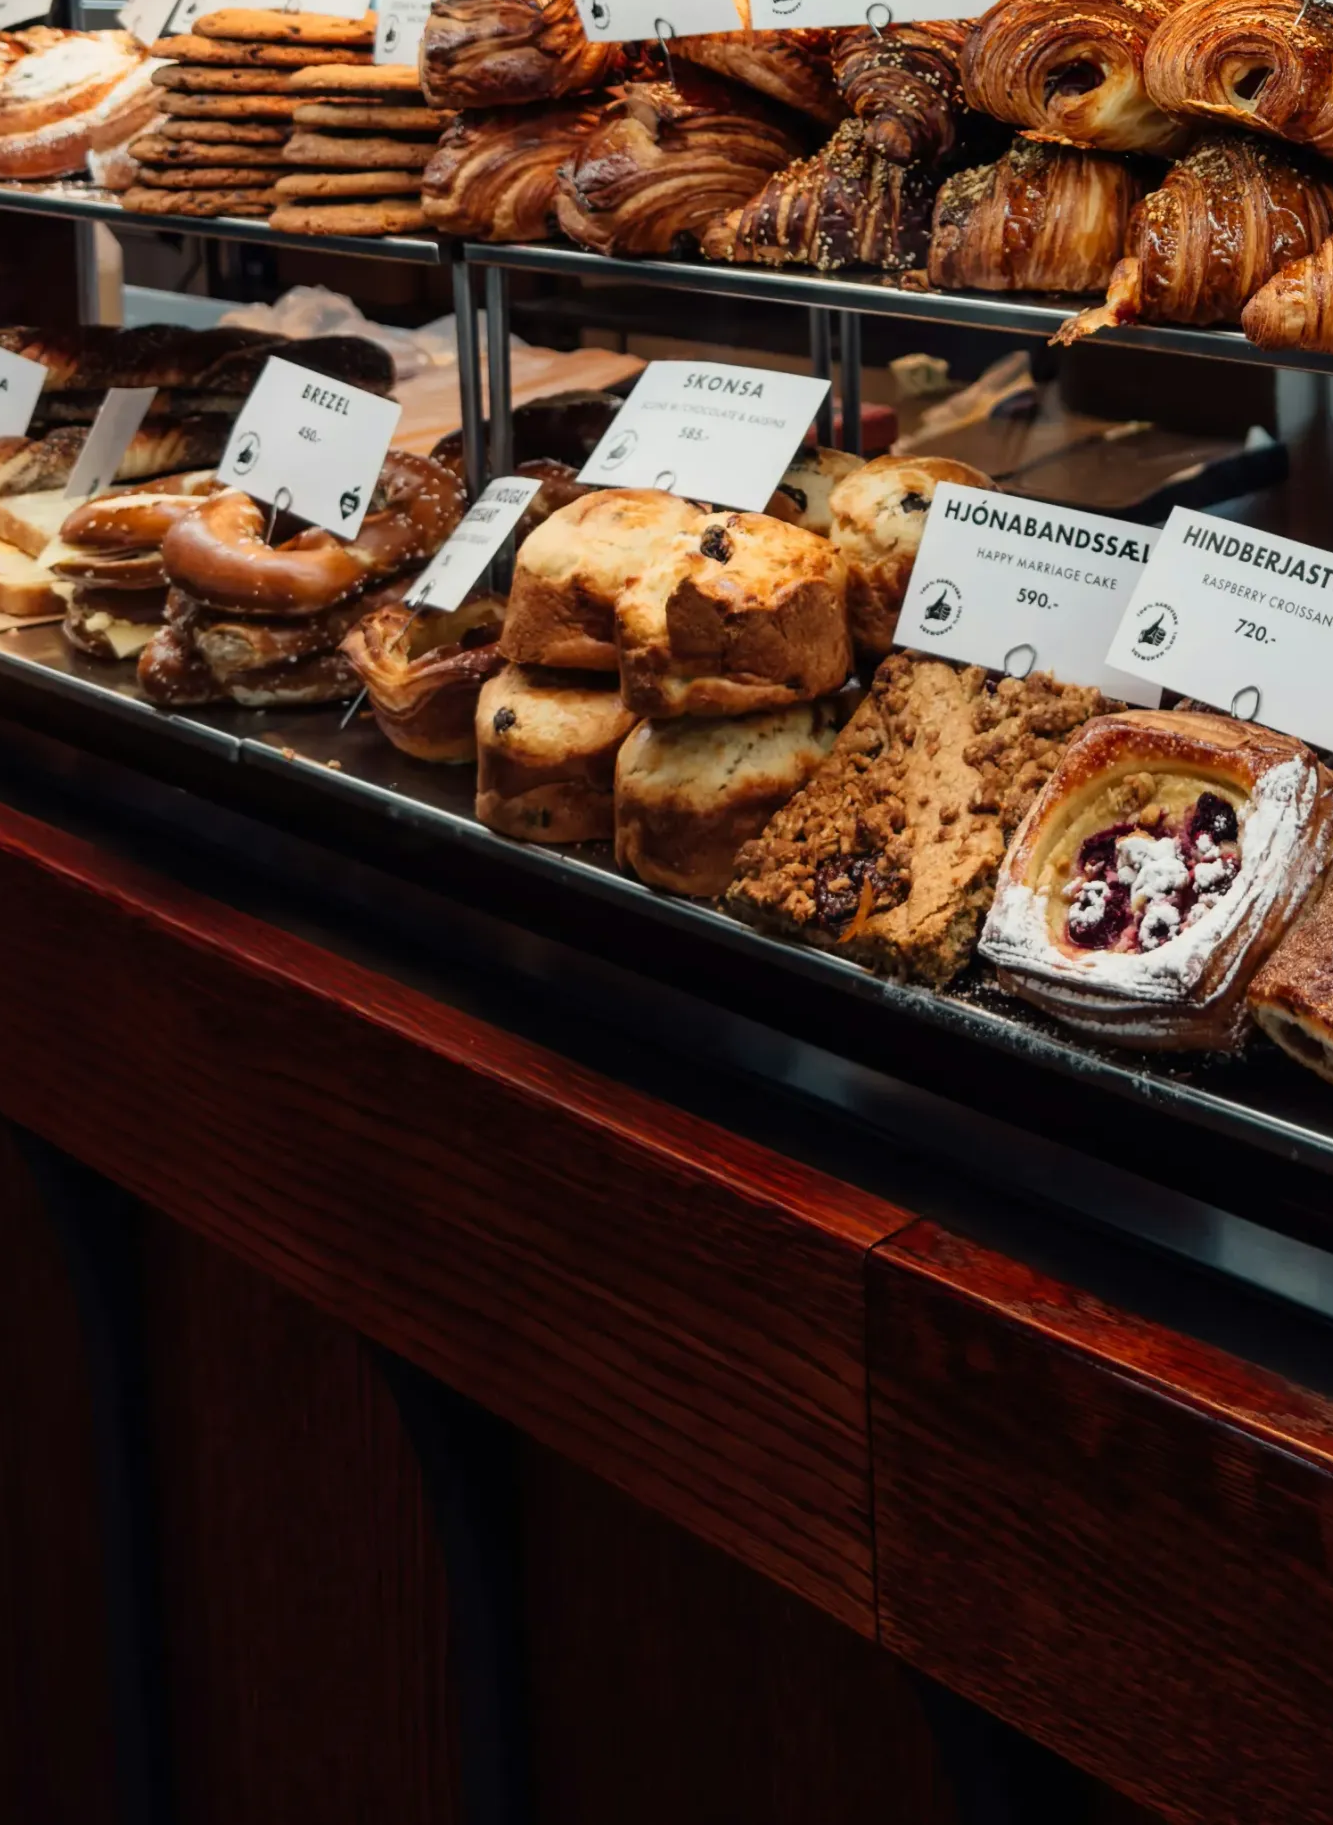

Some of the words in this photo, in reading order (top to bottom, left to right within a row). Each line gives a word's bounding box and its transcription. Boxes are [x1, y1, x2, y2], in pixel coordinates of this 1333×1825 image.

[301, 383, 350, 416] BREZEL
[683, 373, 764, 399] SKONSA
[297, 426, 321, 443] 450.-
[944, 499, 1150, 565] HJÓNABANDSSÆL
[976, 548, 1014, 564] HAPPY
[1016, 558, 1081, 582] MARRIAGE
[1084, 572, 1118, 591] CAKE
[1016, 587, 1059, 610] 590.-
[1201, 573, 1267, 603] RASPBERRY
[1234, 618, 1276, 644] 720.-
